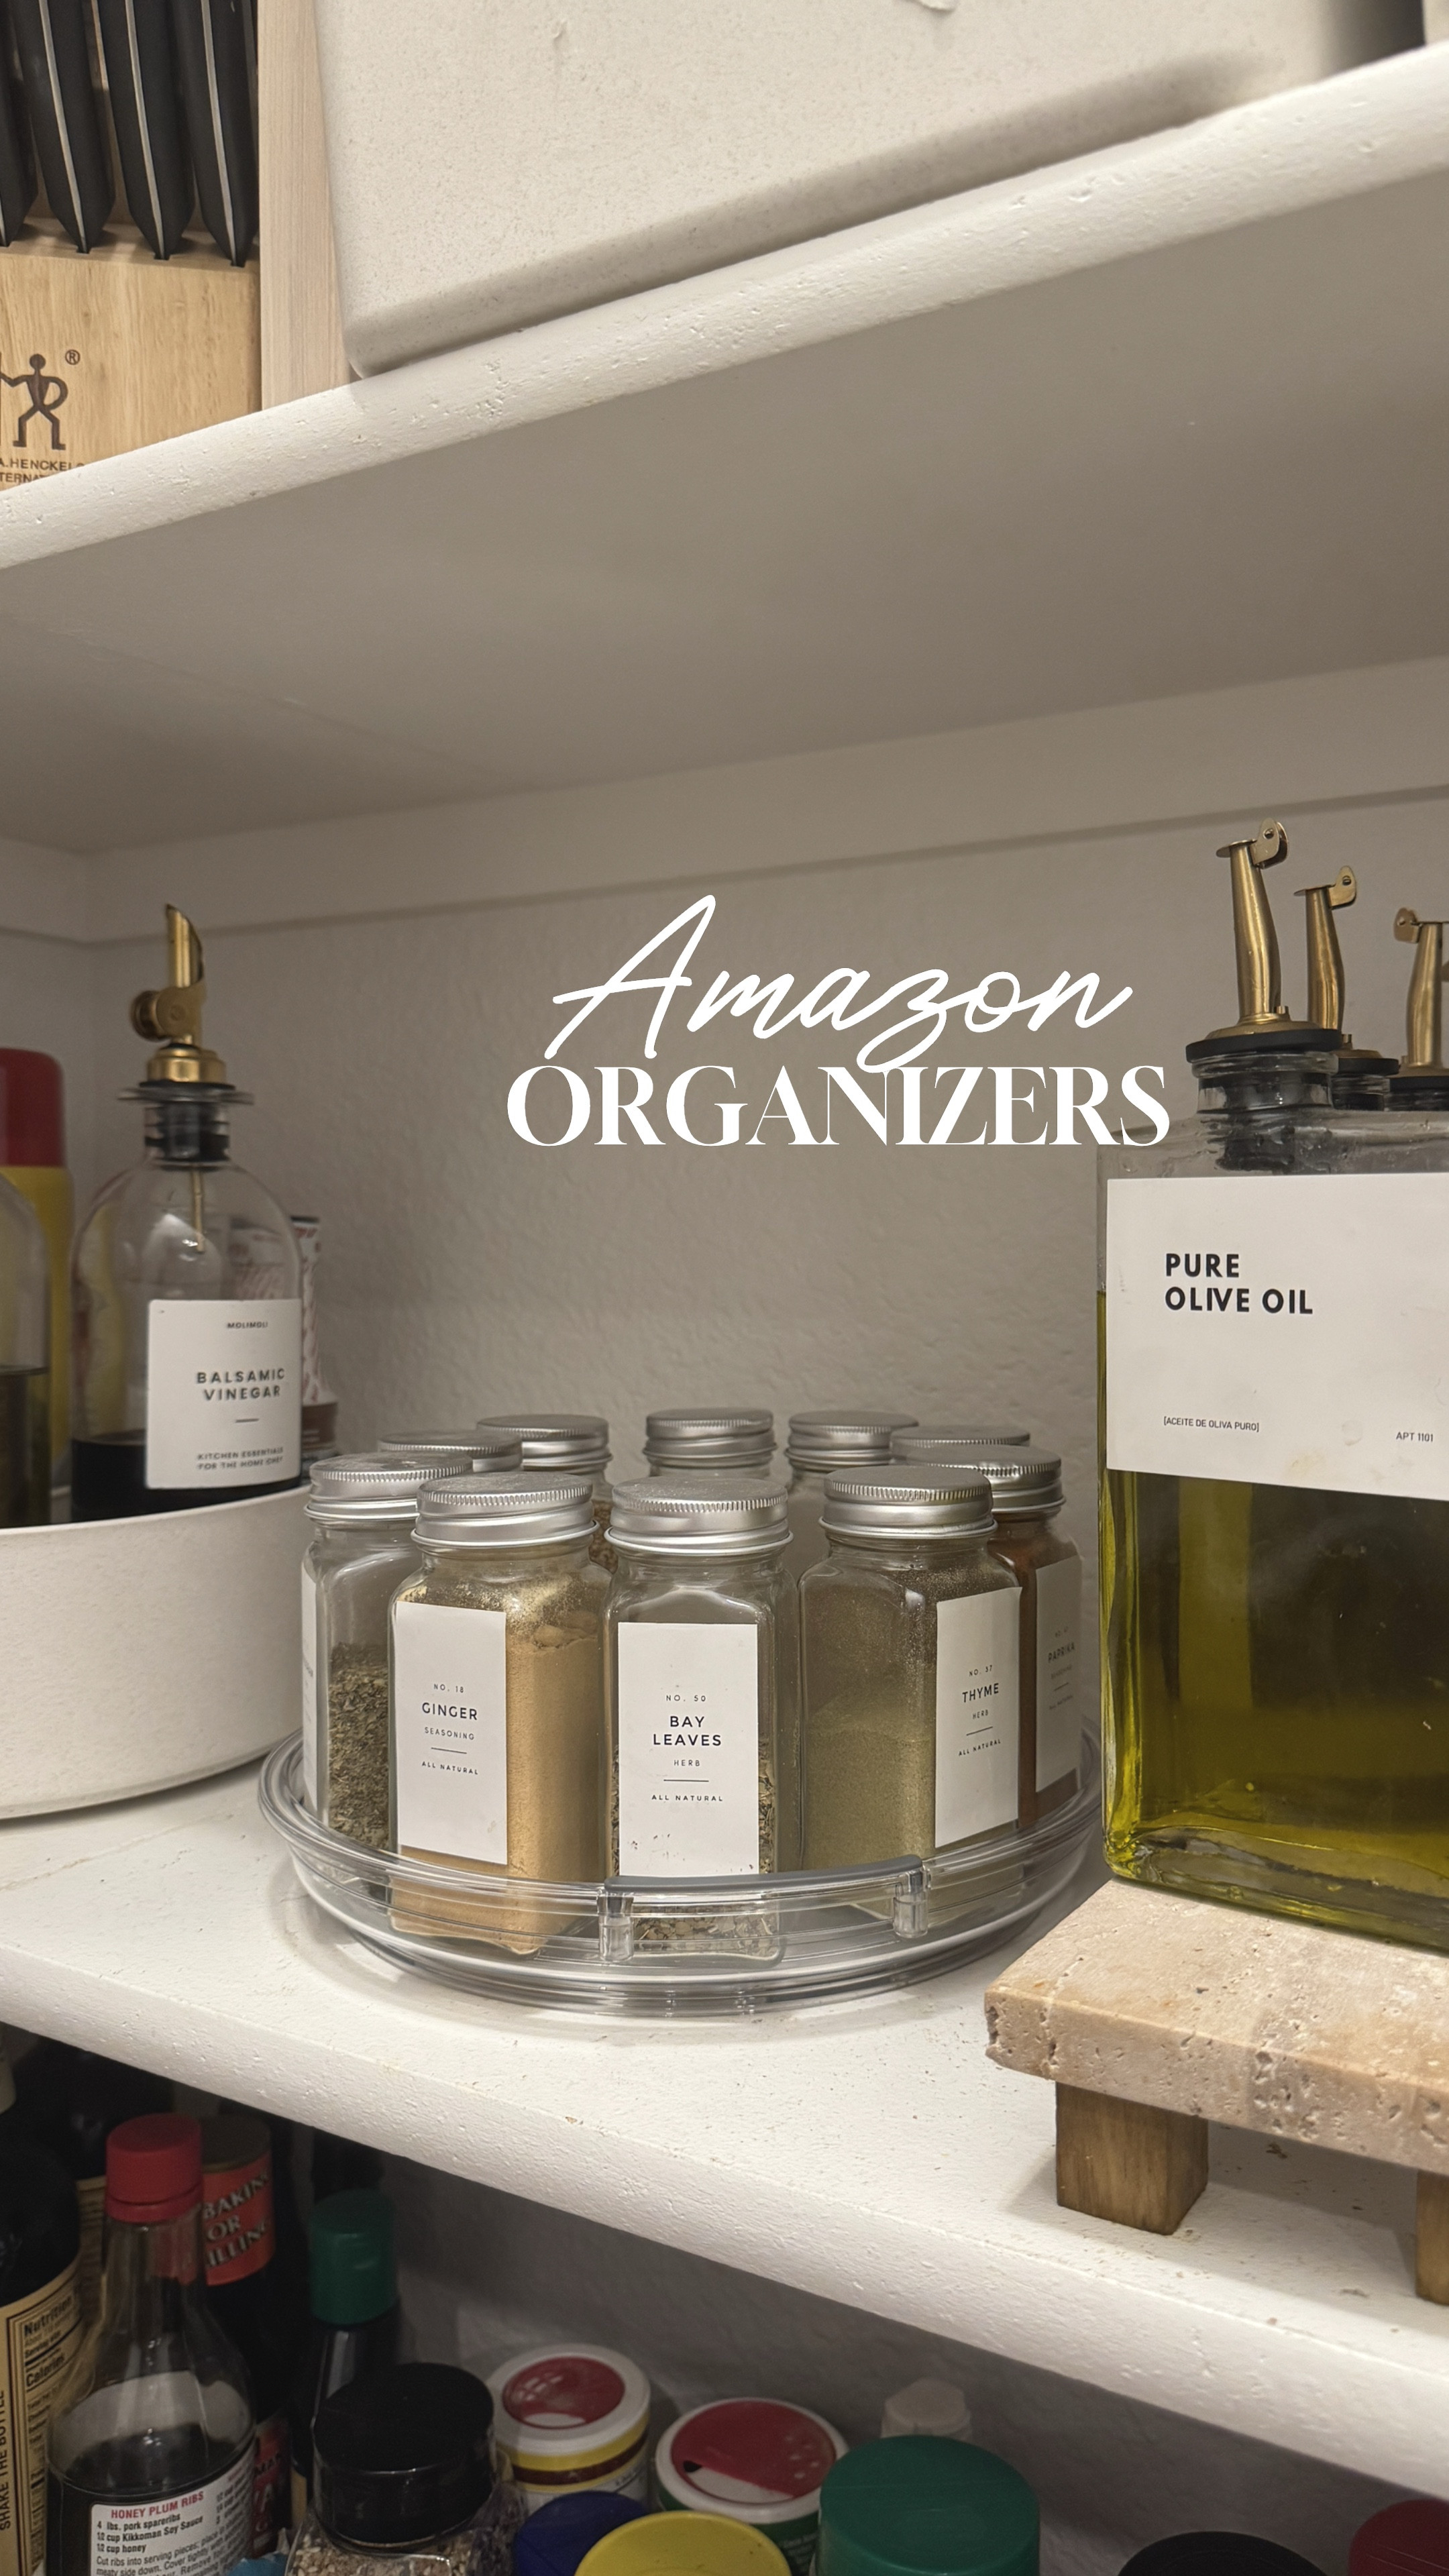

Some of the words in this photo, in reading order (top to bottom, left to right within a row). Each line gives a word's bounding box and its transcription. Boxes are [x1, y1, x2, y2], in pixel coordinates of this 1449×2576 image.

[1166, 1252, 1240, 1278] PURE
[1165, 1286, 1250, 1312] OLIVE
[1262, 1289, 1313, 1315] OIL
[197, 1368, 285, 1385] BALSAMIC
[204, 1385, 280, 1401] VINEGAR
[1164, 1416, 1193, 1426] [ACEITE
[1195, 1419, 1207, 1428] DE
[1208, 1419, 1233, 1429] OLIVA
[1234, 1421, 1260, 1432] PURO]
[1395, 1432, 1415, 1441] APT
[197, 1452, 239, 1461] KITCHEN
[197, 1462, 217, 1470] FOR
[433, 1683, 450, 1693] NO.
[455, 1685, 464, 1693] 18
[962, 1682, 999, 1703] THYME
[422, 1702, 478, 1721] GINGER
[972, 1709, 989, 1719] HERB
[670, 1715, 705, 1728] BAY
[424, 1726, 475, 1740] SEASONING
[653, 1733, 722, 1747] LEAVES
[958, 1748, 970, 1756] ALL
[973, 1738, 1002, 1752] NATURAL
[421, 1760, 436, 1768] ALL
[440, 1764, 478, 1775] NATURAL
[674, 1759, 701, 1767] HERB
[0, 2481, 11, 2531] SHAKE
[111, 2508, 146, 2519] HONEY
[148, 2500, 178, 2516] PLUM
[181, 2491, 204, 2508] RIBS
[97, 2520, 103, 2529] 4
[107, 2521, 121, 2531] lbs.
[123, 2521, 142, 2532] pork
[144, 2514, 181, 2528] spareribs
[107, 2534, 121, 2543] cup
[123, 2530, 162, 2542] Kikkoman
[164, 2524, 178, 2536] Soy
[180, 2516, 203, 2530] Sauce
[107, 2545, 121, 2555] cup
[122, 2543, 147, 2553] honey
[97, 2556, 109, 2566] Cut
[111, 2557, 125, 2566] ribs
[126, 2557, 142, 2566] into
[164, 2557, 186, 2571] Cover
